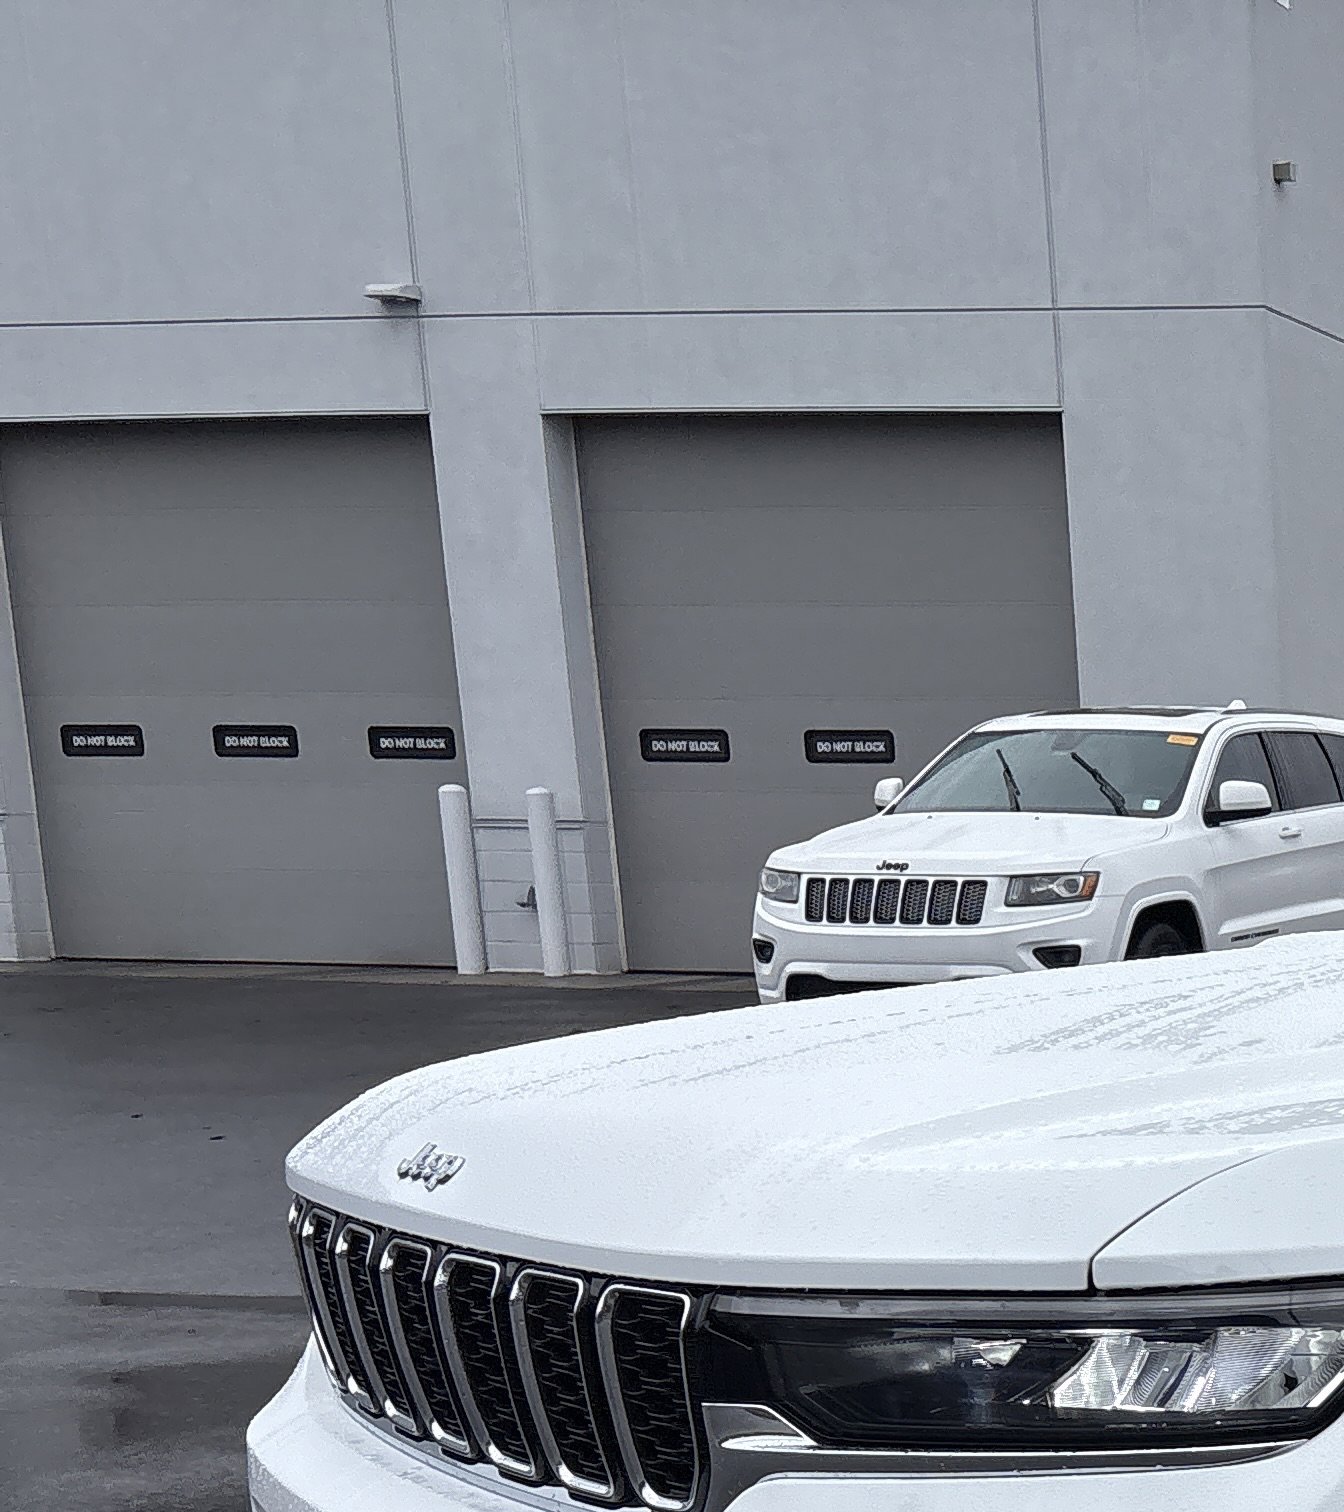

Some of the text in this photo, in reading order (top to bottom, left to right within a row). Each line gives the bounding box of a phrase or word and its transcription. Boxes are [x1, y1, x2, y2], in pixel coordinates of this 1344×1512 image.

[72, 736, 136, 747] DO NOT BLOCK
[224, 736, 289, 747] DO NOT BLOCK
[379, 737, 447, 749] DO NOT BLOCK
[651, 740, 721, 752] DO NOT BLOCK
[816, 741, 886, 753] DO NOT BLOCK
[876, 860, 909, 872] Jeep
[397, 1142, 466, 1193] Jeep
